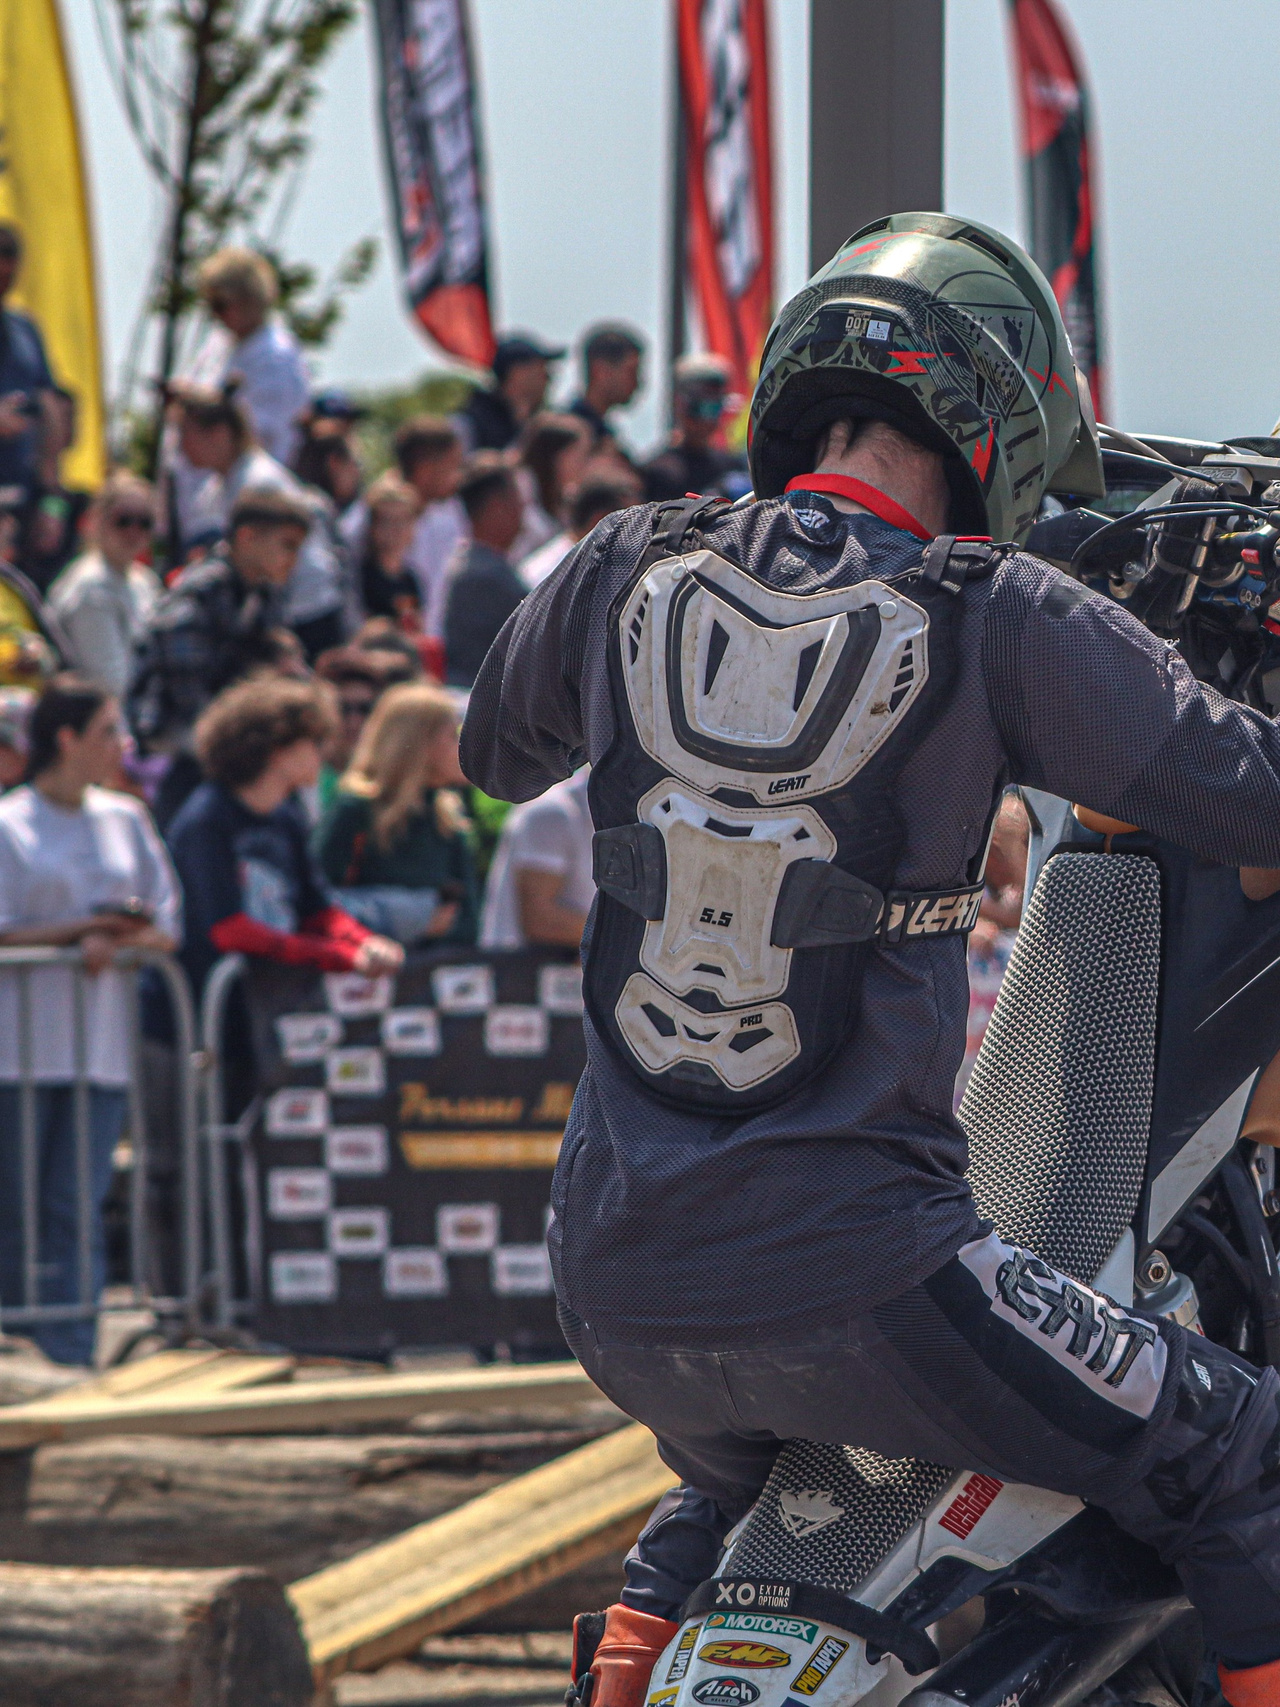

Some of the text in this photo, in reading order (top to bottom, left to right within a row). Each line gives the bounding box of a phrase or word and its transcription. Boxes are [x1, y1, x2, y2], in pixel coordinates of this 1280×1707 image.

[845, 316, 870, 330] DOT
[768, 775, 811, 795] LEATT
[700, 907, 733, 928] 5.5
[740, 1013, 762, 1028] PRO
[715, 1582, 756, 1606] XO
[759, 1584, 791, 1597] EXTRA
[758, 1595, 790, 1608] OPTIONS
[725, 1614, 813, 1640] MOTOREX
[669, 1627, 699, 1681] PRO TAPER
[697, 1644, 792, 1664] FMF
[796, 1639, 845, 1695] PRO TAPER
[696, 1680, 753, 1701] Airoh
